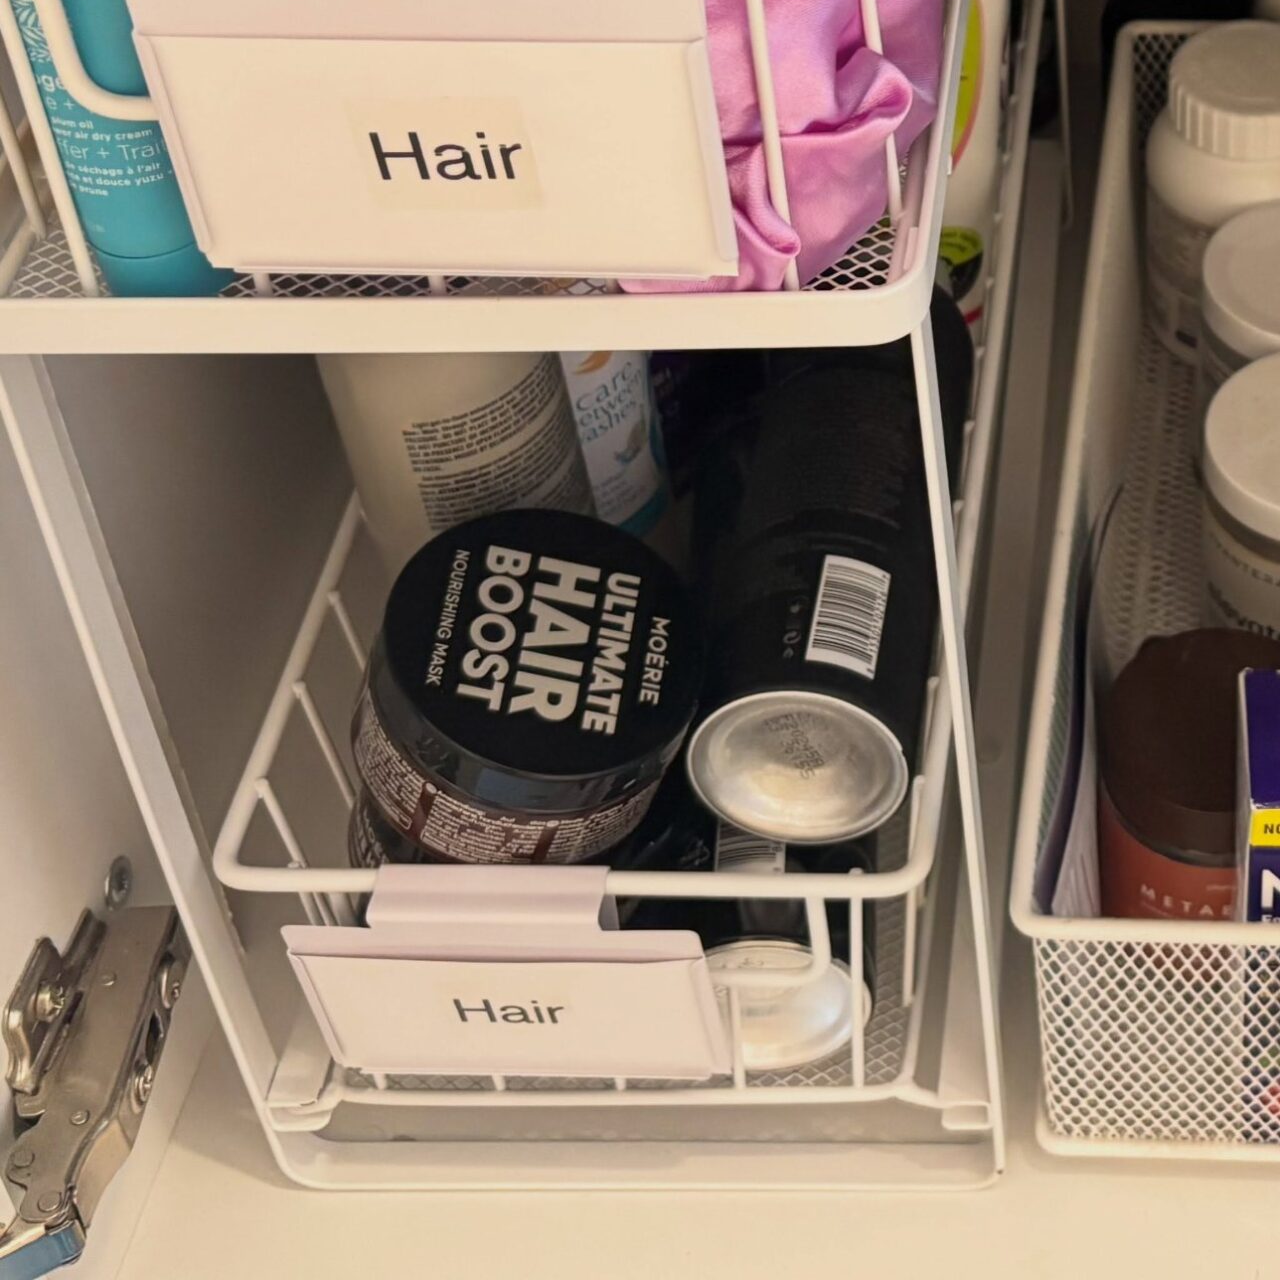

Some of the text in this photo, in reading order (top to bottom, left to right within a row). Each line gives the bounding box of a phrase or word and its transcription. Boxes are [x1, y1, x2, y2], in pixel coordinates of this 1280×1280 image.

[91, 132, 112, 143] dry
[115, 128, 153, 141] cream
[96, 176, 132, 186] douce
[134, 173, 164, 186] yuzu
[369, 130, 522, 181] Hair
[425, 549, 471, 687] NOURISHING MASK
[456, 545, 532, 712] BOOST
[507, 556, 601, 721] HAIR
[581, 572, 642, 735] ULTIMATE
[452, 998, 565, 1026] Hair
